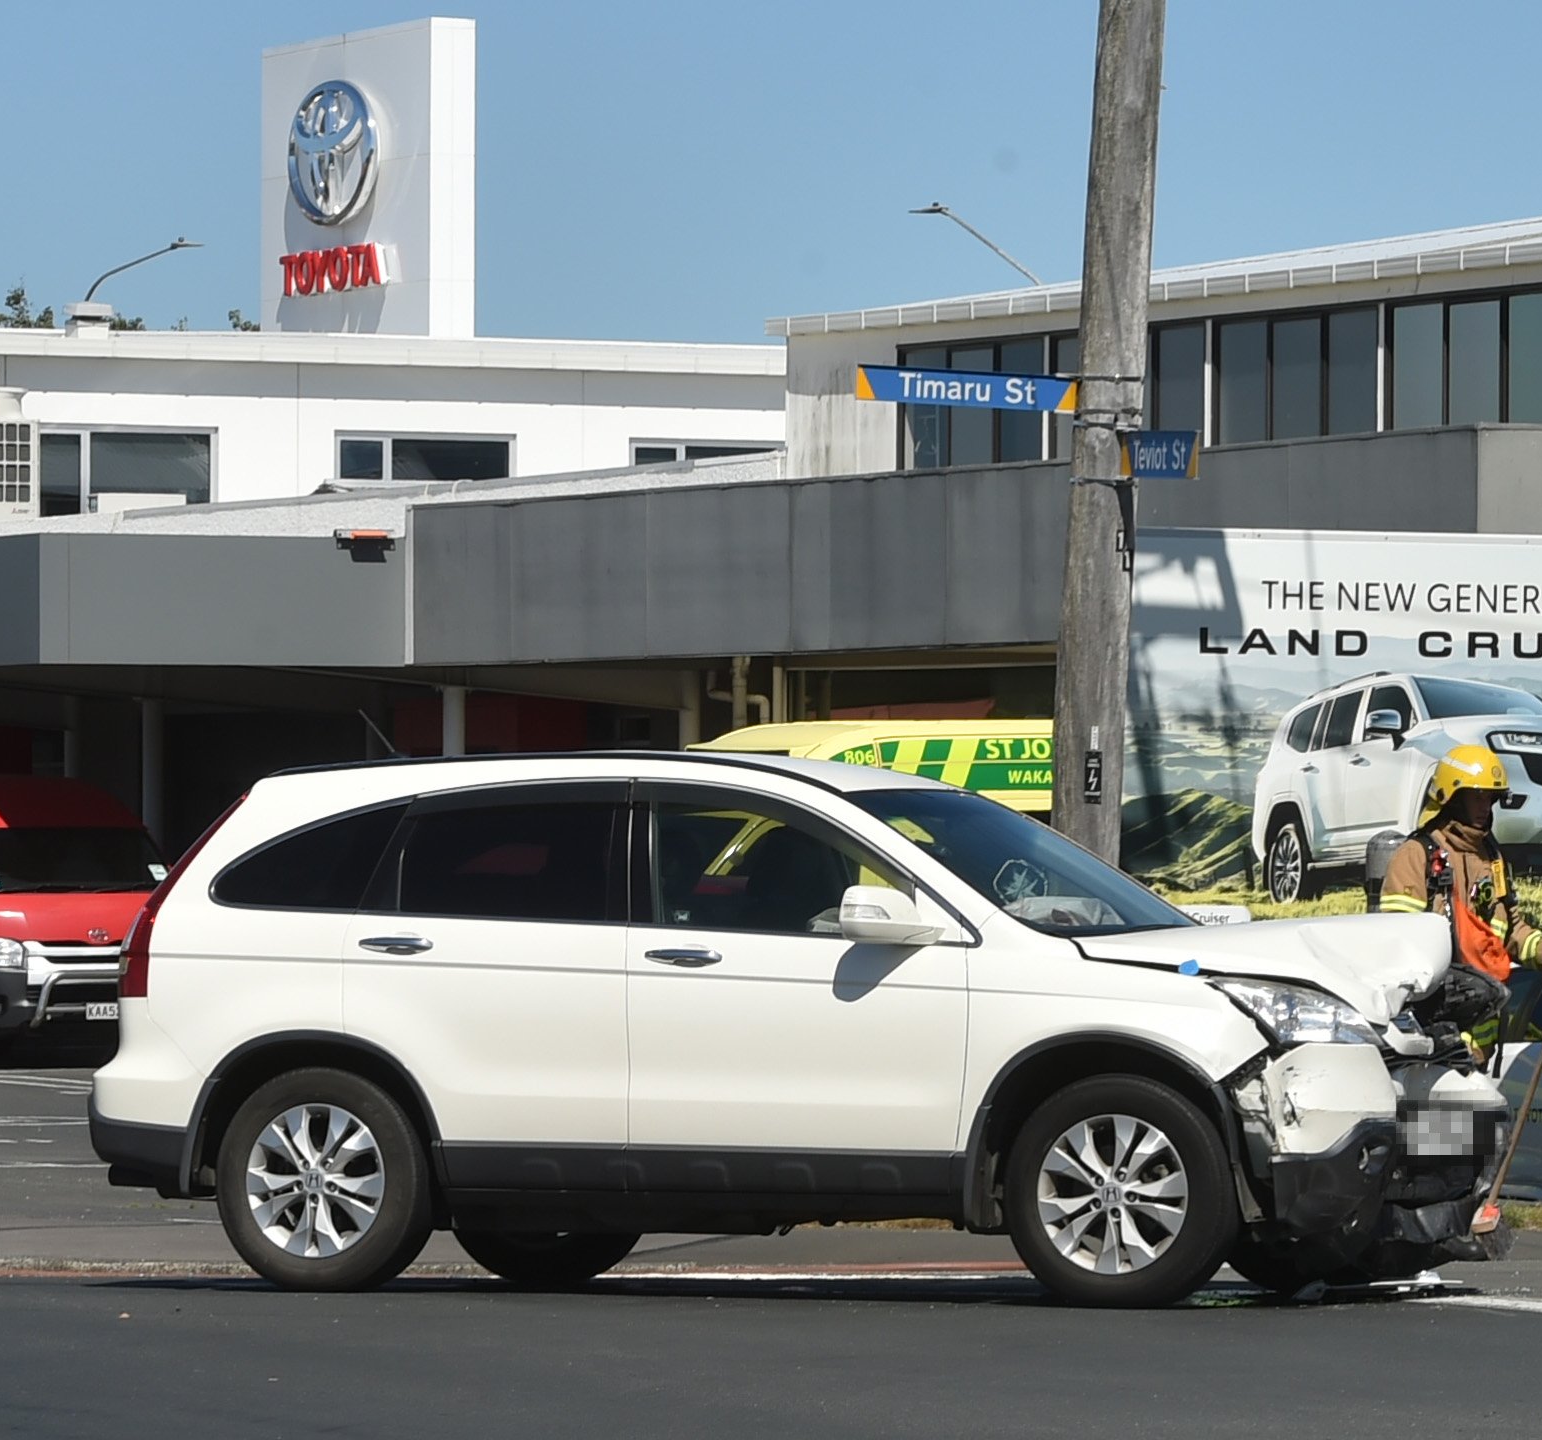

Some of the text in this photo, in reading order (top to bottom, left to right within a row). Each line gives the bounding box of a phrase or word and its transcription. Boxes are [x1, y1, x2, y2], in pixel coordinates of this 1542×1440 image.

[280, 242, 383, 297] TOYOTA
[898, 372, 1037, 406] Timaru St
[1133, 440, 1187, 471] Teviot St
[1261, 580, 1324, 611] THE
[1338, 581, 1417, 613] NEW
[1199, 627, 1369, 657] LAND
[844, 750, 875, 765] 806
[985, 739, 1013, 760] ST
[1008, 769, 1052, 785] WAKA
[88, 1005, 119, 1017] KAA5
